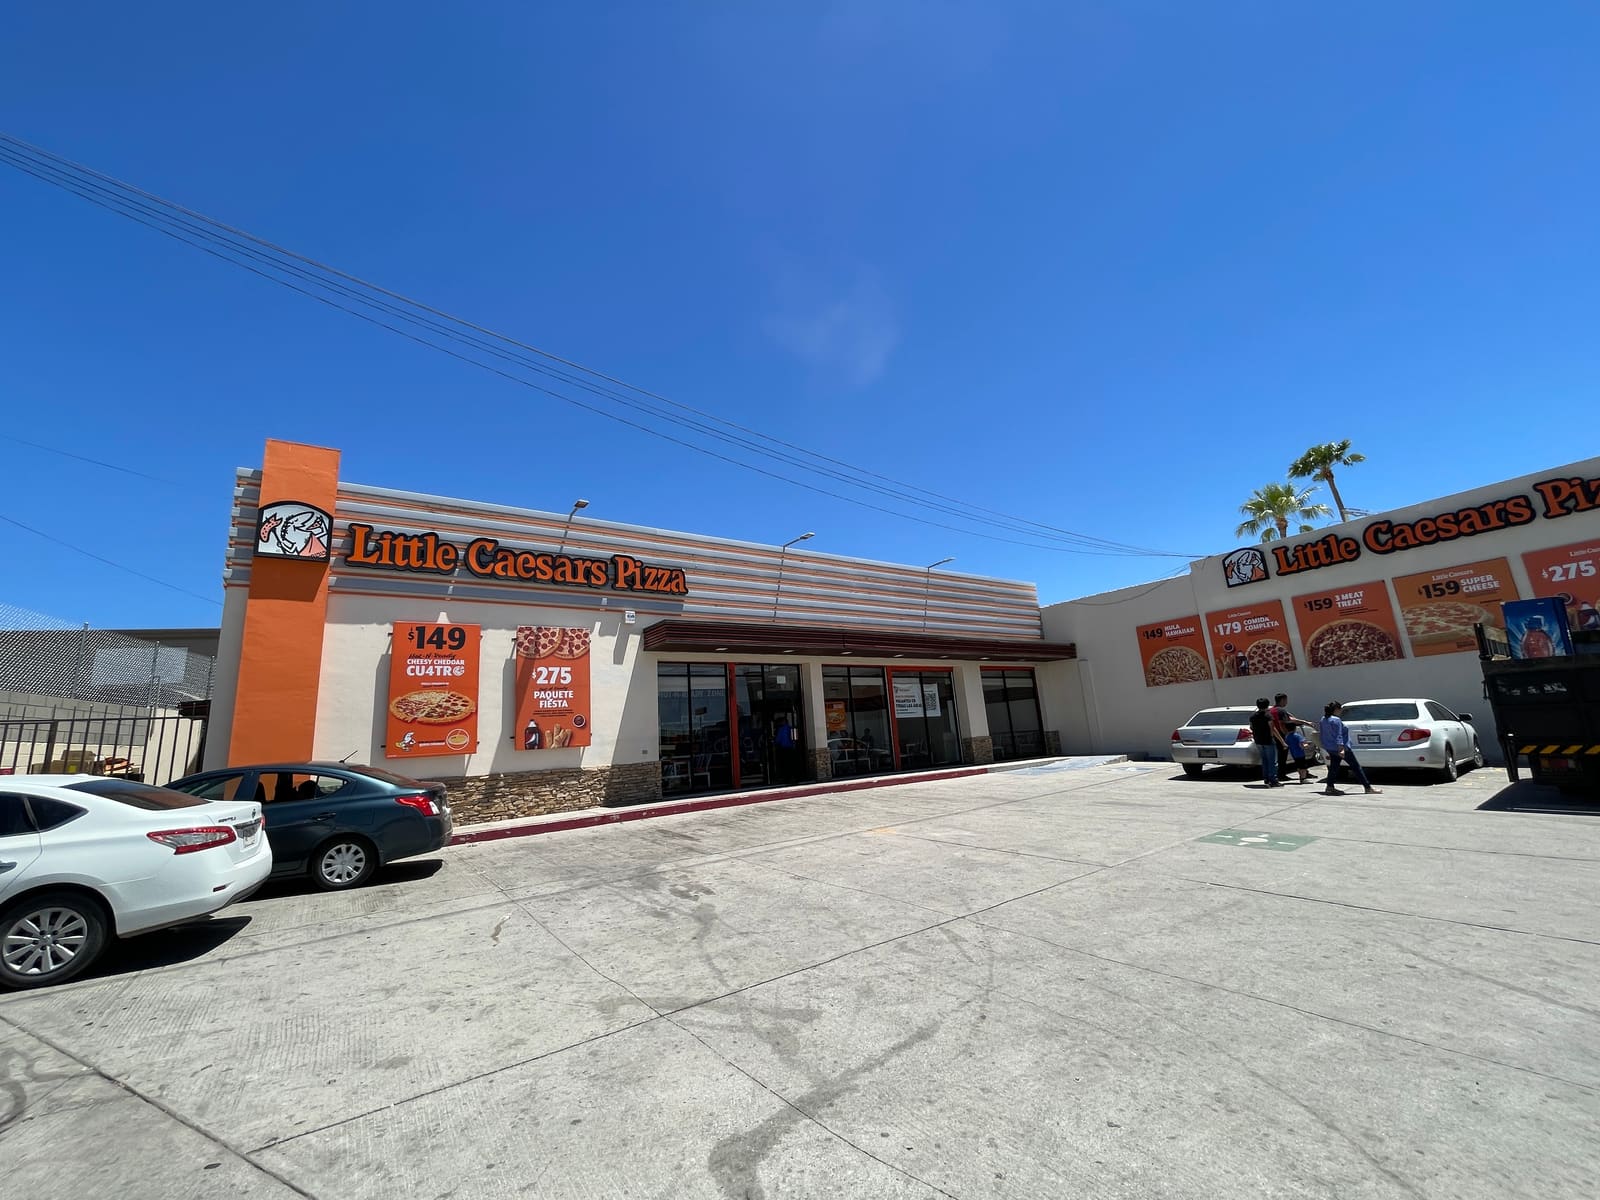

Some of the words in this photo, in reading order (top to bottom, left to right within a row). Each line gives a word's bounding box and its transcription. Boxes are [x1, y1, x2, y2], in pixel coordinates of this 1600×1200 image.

[1272, 535, 1358, 574] Little
[1364, 497, 1532, 552] Caesars
[346, 524, 456, 571] Little
[466, 539, 608, 586] Caesars
[613, 555, 687, 594] Pizza
[1542, 560, 1596, 582] $275
[1460, 574, 1494, 586] SUPER
[1462, 580, 1501, 593] CHEESE
[1341, 591, 1364, 600] MEAT
[1418, 580, 1460, 599] $159
[1304, 598, 1333, 612] $159
[1336, 599, 1362, 608] TREAT
[1243, 616, 1270, 626] COMIDA
[1244, 621, 1280, 632] COMPLETA
[408, 625, 466, 651] $149
[531, 666, 572, 685] $275
[533, 690, 574, 700] PAQUETE
